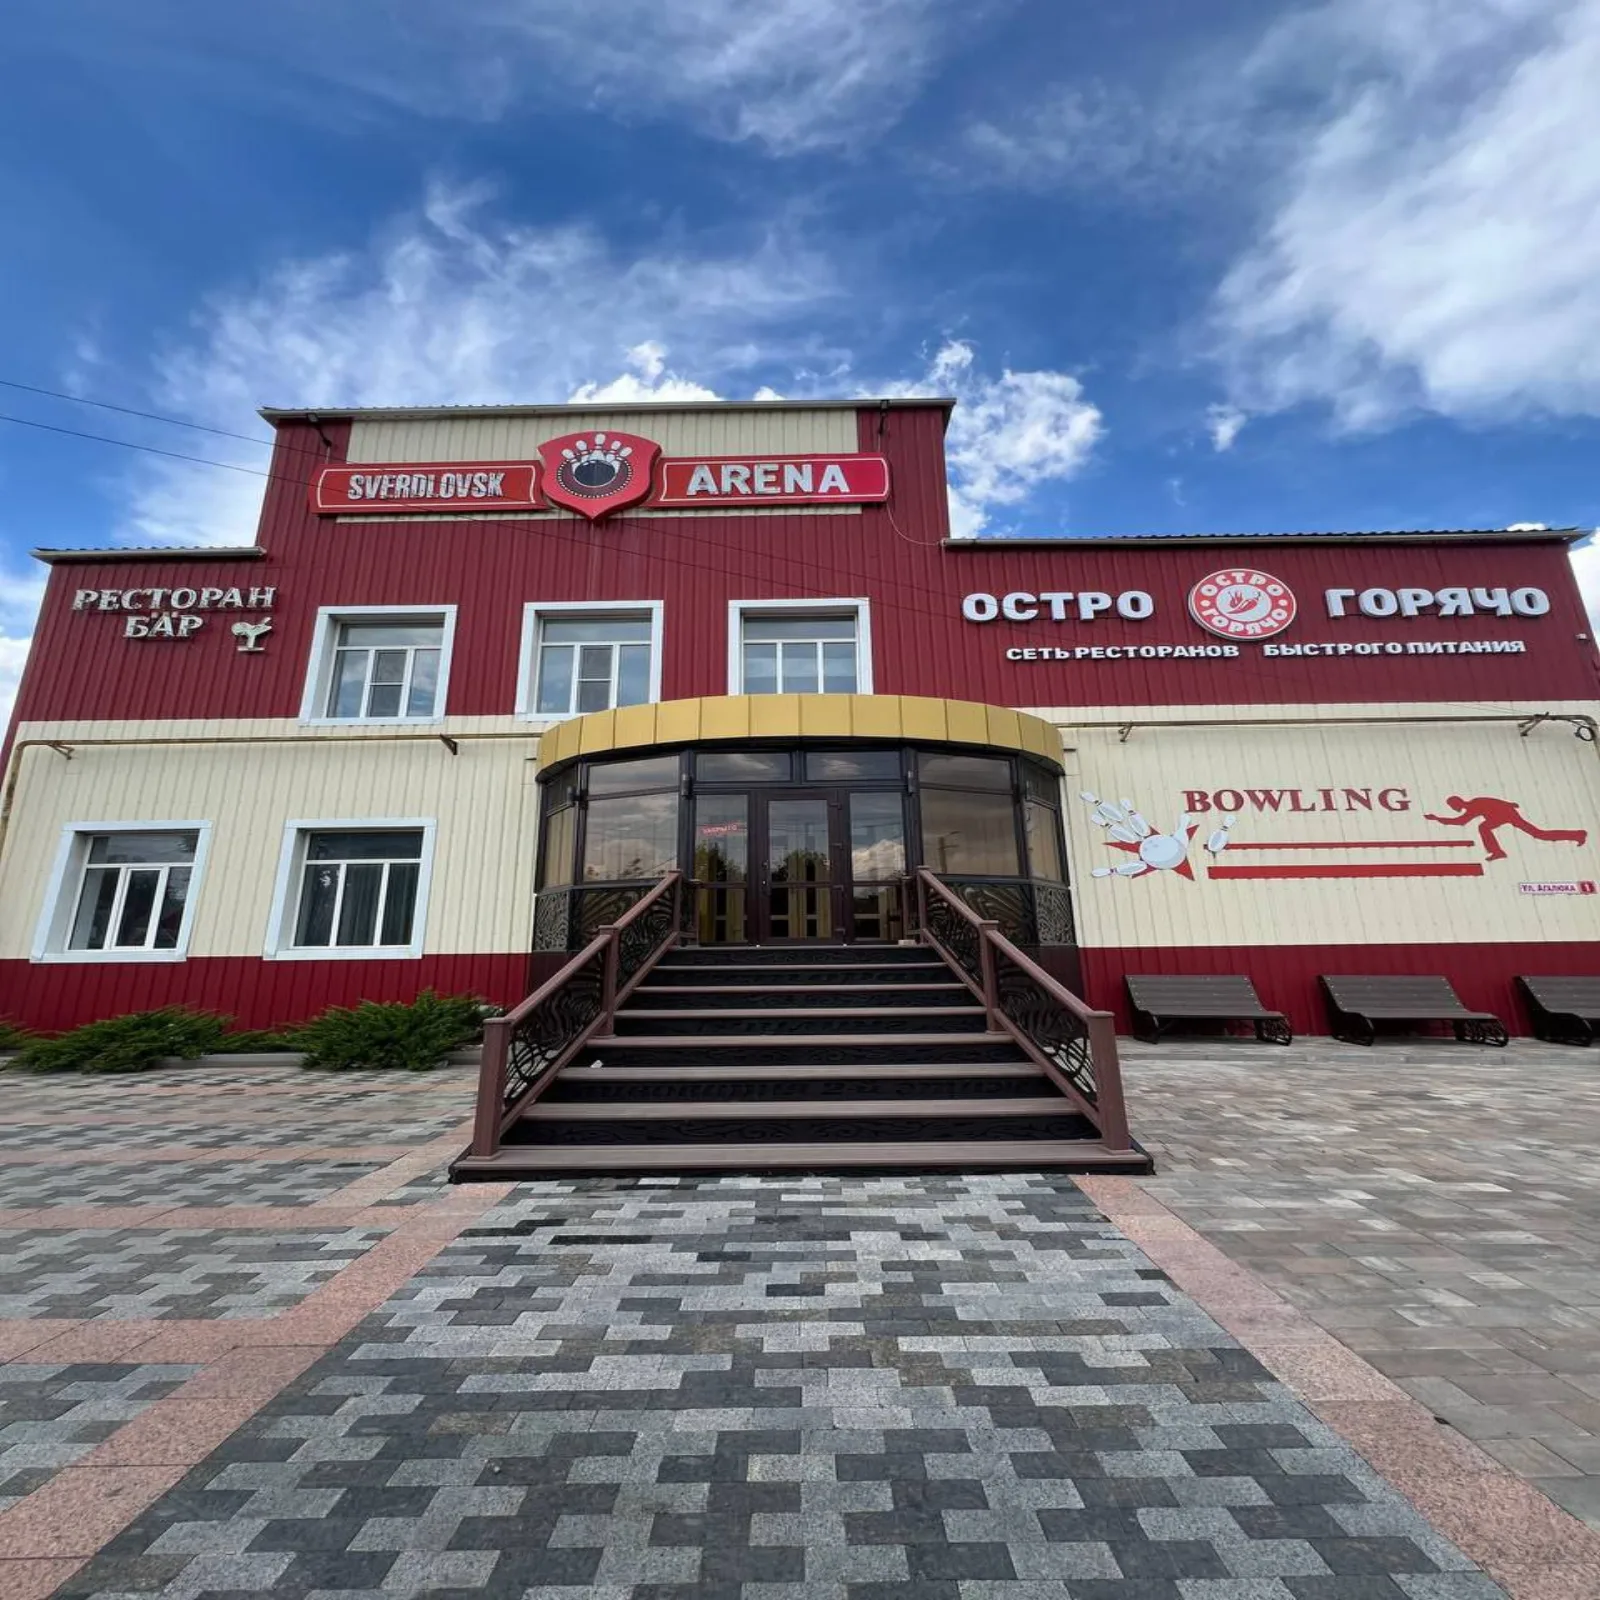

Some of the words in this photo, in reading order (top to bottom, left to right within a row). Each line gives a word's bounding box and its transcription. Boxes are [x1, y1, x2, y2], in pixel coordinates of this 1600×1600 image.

[347, 472, 505, 500] SVERDLOVSK
[686, 463, 850, 496] ARENA
[1200, 572, 1284, 596] ОСТРО
[71, 586, 276, 611] РЕСТОРАН
[962, 590, 1154, 621] ОСТРО
[1324, 587, 1551, 618] ГОРЯЧО
[123, 613, 204, 639] БАР
[1201, 608, 1288, 635] ГОРЯЧО
[1006, 648, 1071, 661] СЕТЬ
[1074, 645, 1240, 659] РЕСТОРАНОВ
[1263, 643, 1403, 657] БЫСТРОГО
[1406, 641, 1526, 655] ПИТАНИЯ
[1181, 788, 1412, 813] BOWLING
